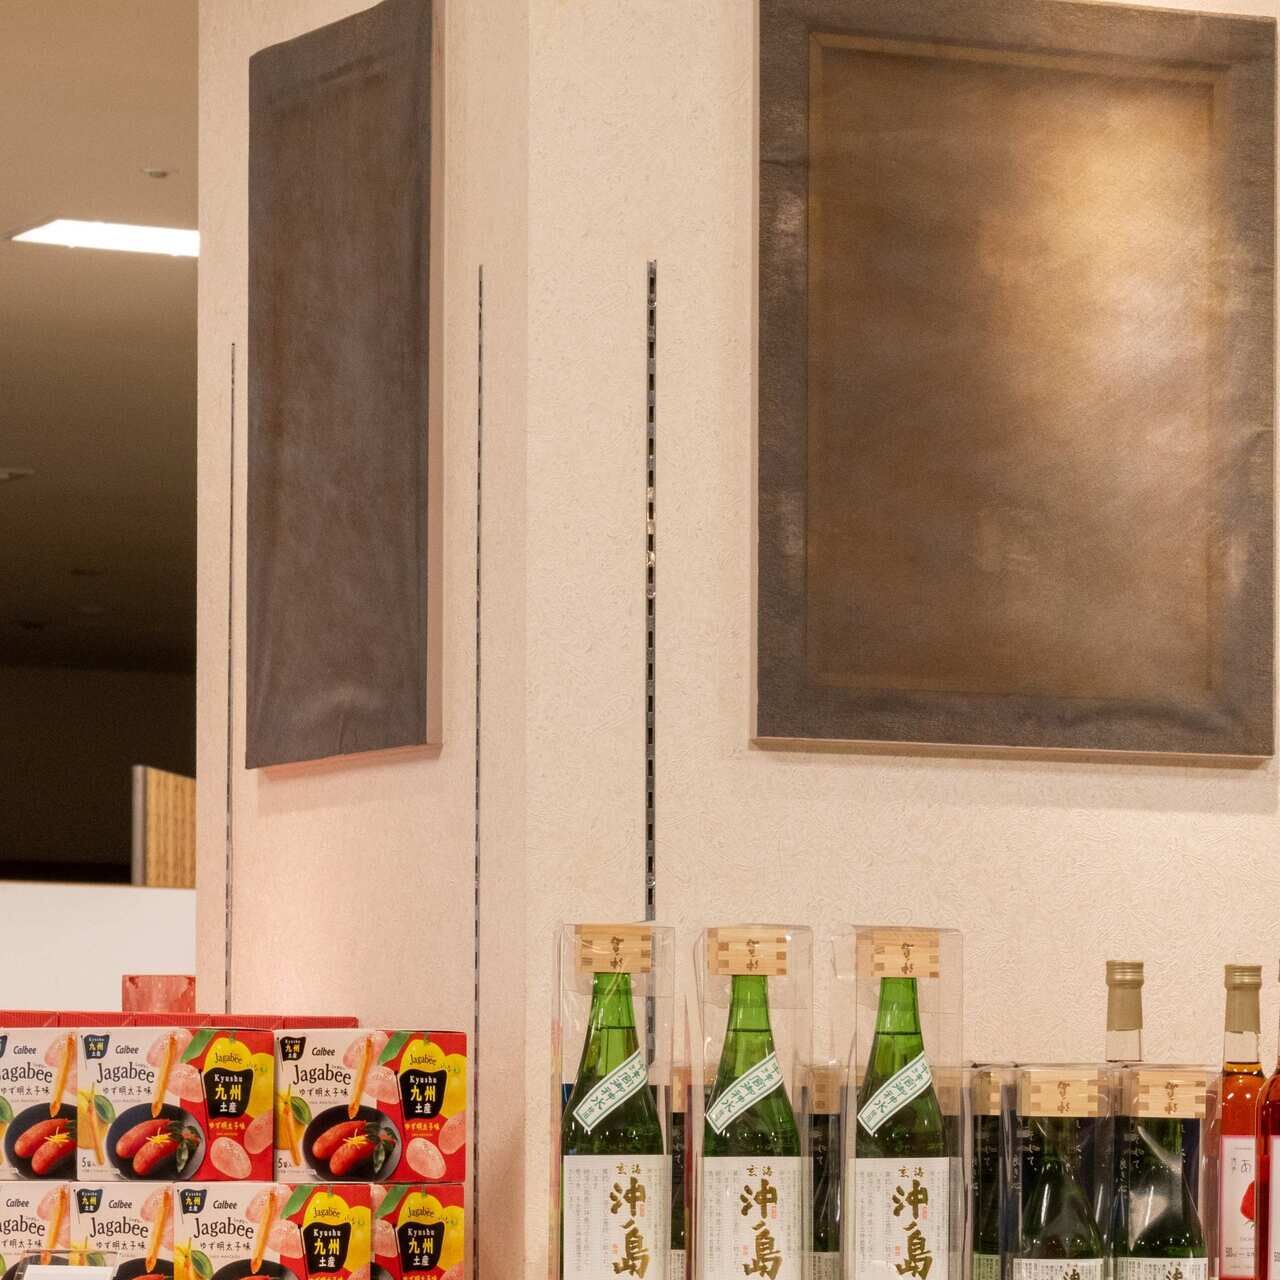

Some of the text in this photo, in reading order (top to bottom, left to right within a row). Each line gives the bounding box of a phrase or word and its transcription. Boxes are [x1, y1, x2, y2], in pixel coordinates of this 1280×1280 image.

[13, 1045, 36, 1055] Calbee
[115, 1045, 139, 1055] Calbee
[312, 1047, 335, 1057] Calbee
[215, 1052, 243, 1064] Jagabee
[409, 1054, 437, 1065] Jagabee
[0, 1062, 53, 1083] agabee
[97, 1062, 155, 1083] Jagabee
[293, 1064, 352, 1085] Jagabee
[214, 1074, 243, 1084] Kyushu
[409, 1075, 437, 1085] Kyushu
[215, 1085, 242, 1101] 九州
[410, 1086, 436, 1102] 九州
[219, 1102, 237, 1113] 土産
[414, 1103, 432, 1114] 土産
[5, 1198, 29, 1208] Calbee
[108, 1199, 133, 1209] Calbee
[213, 1200, 237, 1210] Calbee
[313, 1207, 341, 1218] Jagabee
[408, 1206, 435, 1217] Jagabee
[0, 1214, 46, 1236] gabee
[89, 1216, 149, 1238] Jagabee
[193, 1217, 254, 1239] Jagabee
[609, 1176, 650, 1280] 沖ノ島
[740, 1179, 783, 1280] 沖ノ島
[892, 1179, 933, 1280] 沖ノ島
[313, 1228, 341, 1238] Kyushu
[408, 1228, 435, 1237] Kyushu
[1, 1240, 42, 1250] ず明太子味
[314, 1238, 340, 1255] 九州
[408, 1238, 434, 1254] 九州
[319, 1256, 336, 1268] 土産
[413, 1255, 430, 1266] 土産
